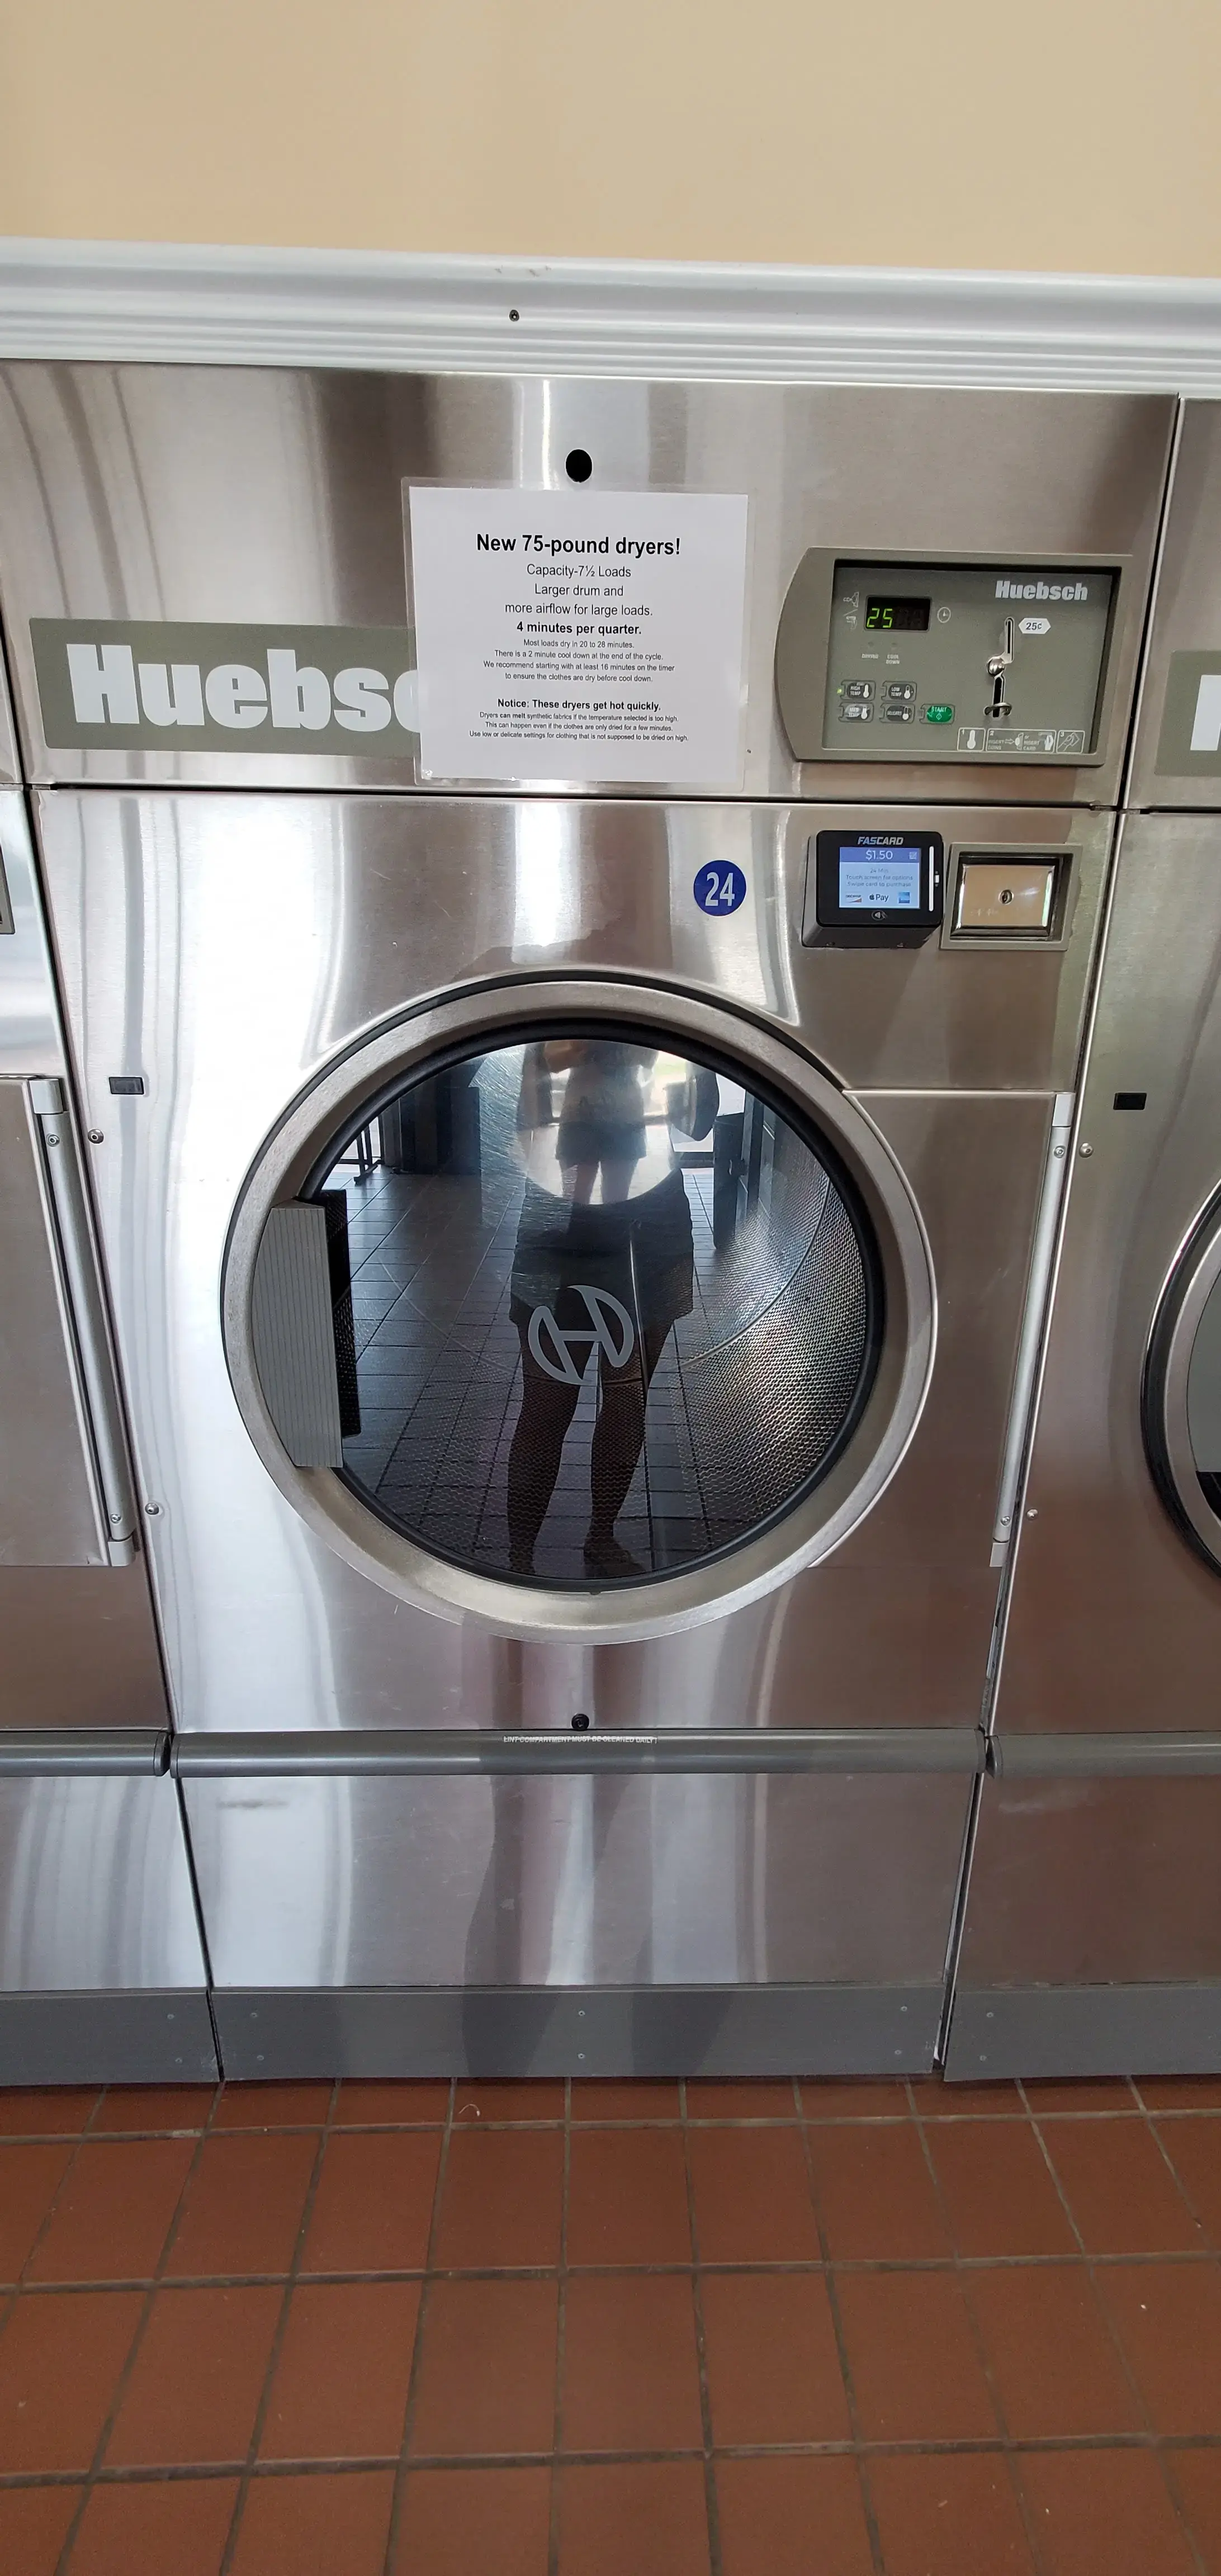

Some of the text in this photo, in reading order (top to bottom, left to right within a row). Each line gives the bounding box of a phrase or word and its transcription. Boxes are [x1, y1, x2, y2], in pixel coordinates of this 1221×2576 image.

[477, 533, 680, 558] New 75-pound dryers!
[599, 565, 631, 577] Loads
[535, 583, 623, 598] Larger drum and
[995, 580, 1088, 600] Huebsch
[505, 603, 652, 618] more airflow for large loads.
[867, 608, 893, 628] 25
[517, 621, 641, 636] 4 minutes per quarter.
[1026, 622, 1042, 630] 25¢
[560, 640, 570, 649] dry
[645, 652, 663, 661] cycle.
[536, 662, 559, 671] starting
[585, 674, 595, 683] dry
[67, 643, 420, 733] Huebs
[498, 698, 660, 712] Notice: These dryers get hot quickly.
[858, 836, 903, 845] FASCARD
[865, 849, 893, 860] $1.50
[706, 872, 735, 906] 24
[875, 894, 889, 902] Pay
